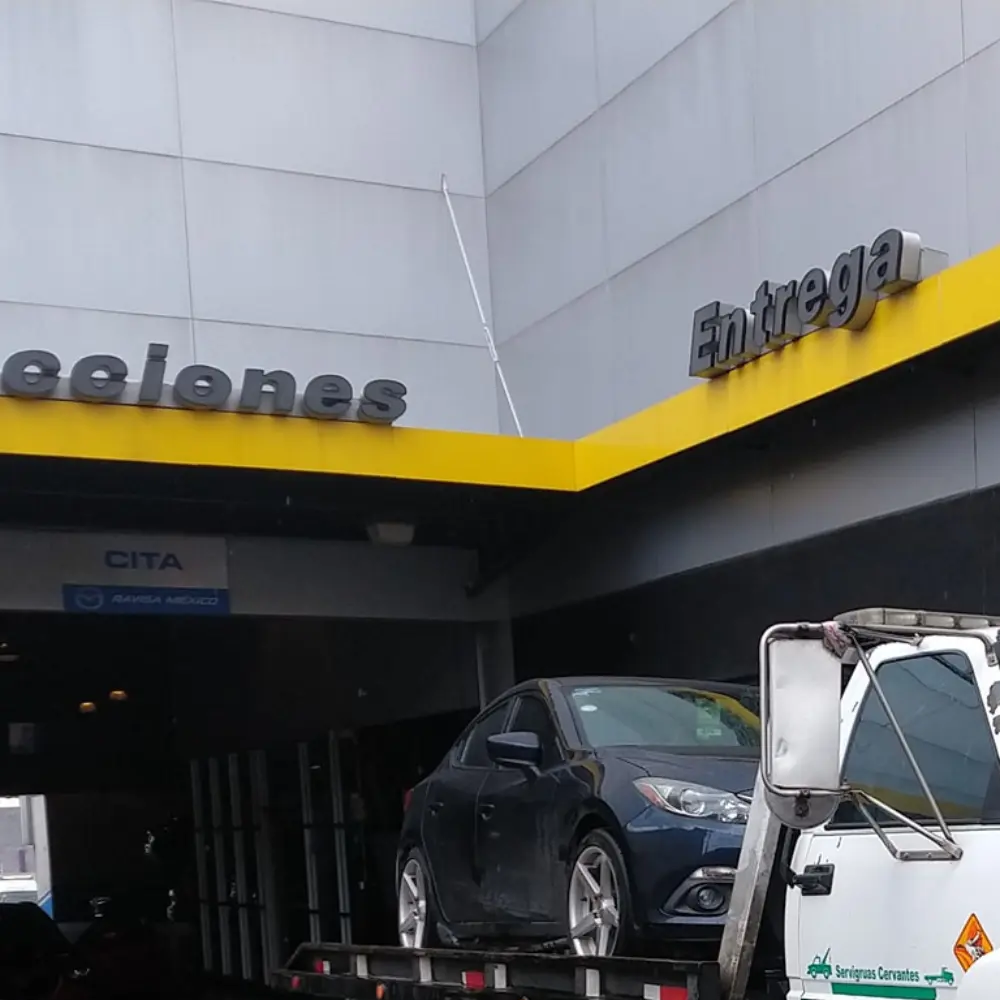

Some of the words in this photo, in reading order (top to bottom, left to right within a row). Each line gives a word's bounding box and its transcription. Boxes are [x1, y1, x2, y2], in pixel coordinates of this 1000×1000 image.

[689, 228, 915, 379] Entrega
[1, 342, 408, 425] cciones
[104, 550, 184, 571] CITA
[835, 964, 876, 982] Servigruas
[878, 966, 920, 982] Cervantes
